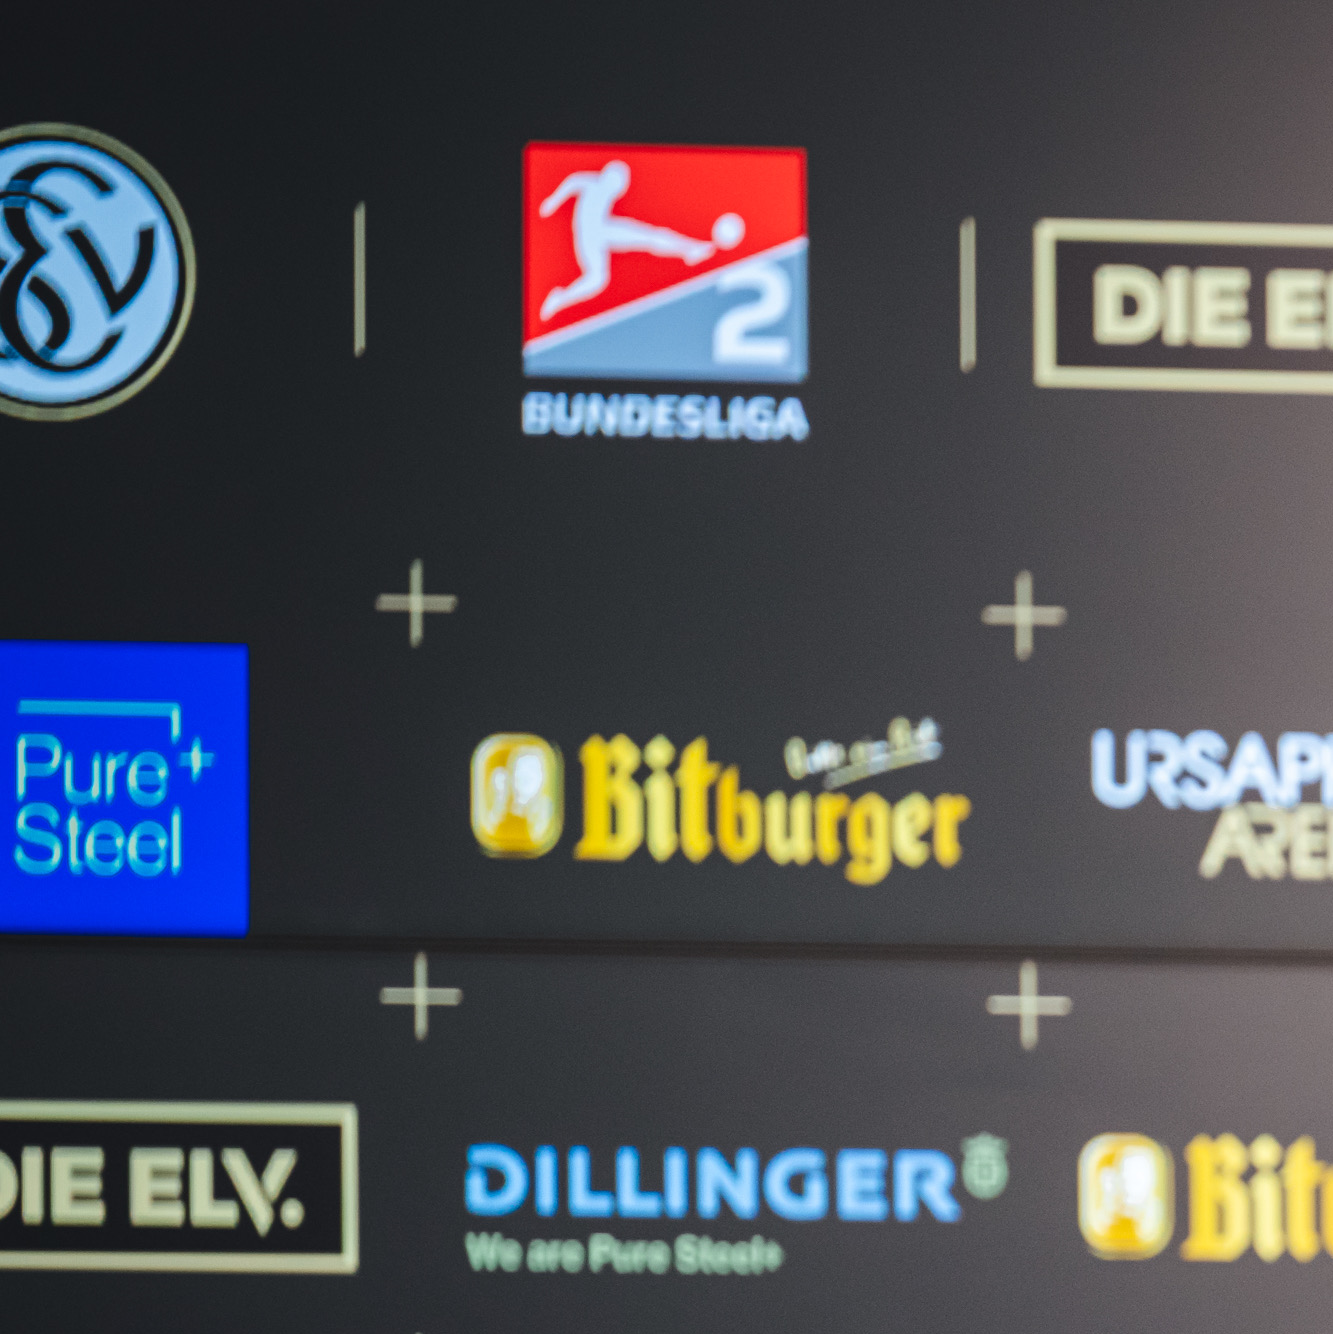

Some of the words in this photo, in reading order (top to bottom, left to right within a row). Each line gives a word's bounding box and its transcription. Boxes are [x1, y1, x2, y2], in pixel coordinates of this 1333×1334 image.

[713, 263, 792, 365] 2
[1094, 264, 1252, 345] DIE
[521, 390, 809, 441] BUNDESLIGA
[14, 802, 182, 877] Steel
[572, 733, 971, 886] Bitburger
[0, 1146, 106, 1226] IE
[464, 1142, 962, 1223] DILLINGER
[465, 1231, 523, 1272] We
[589, 1232, 671, 1274] Pure
